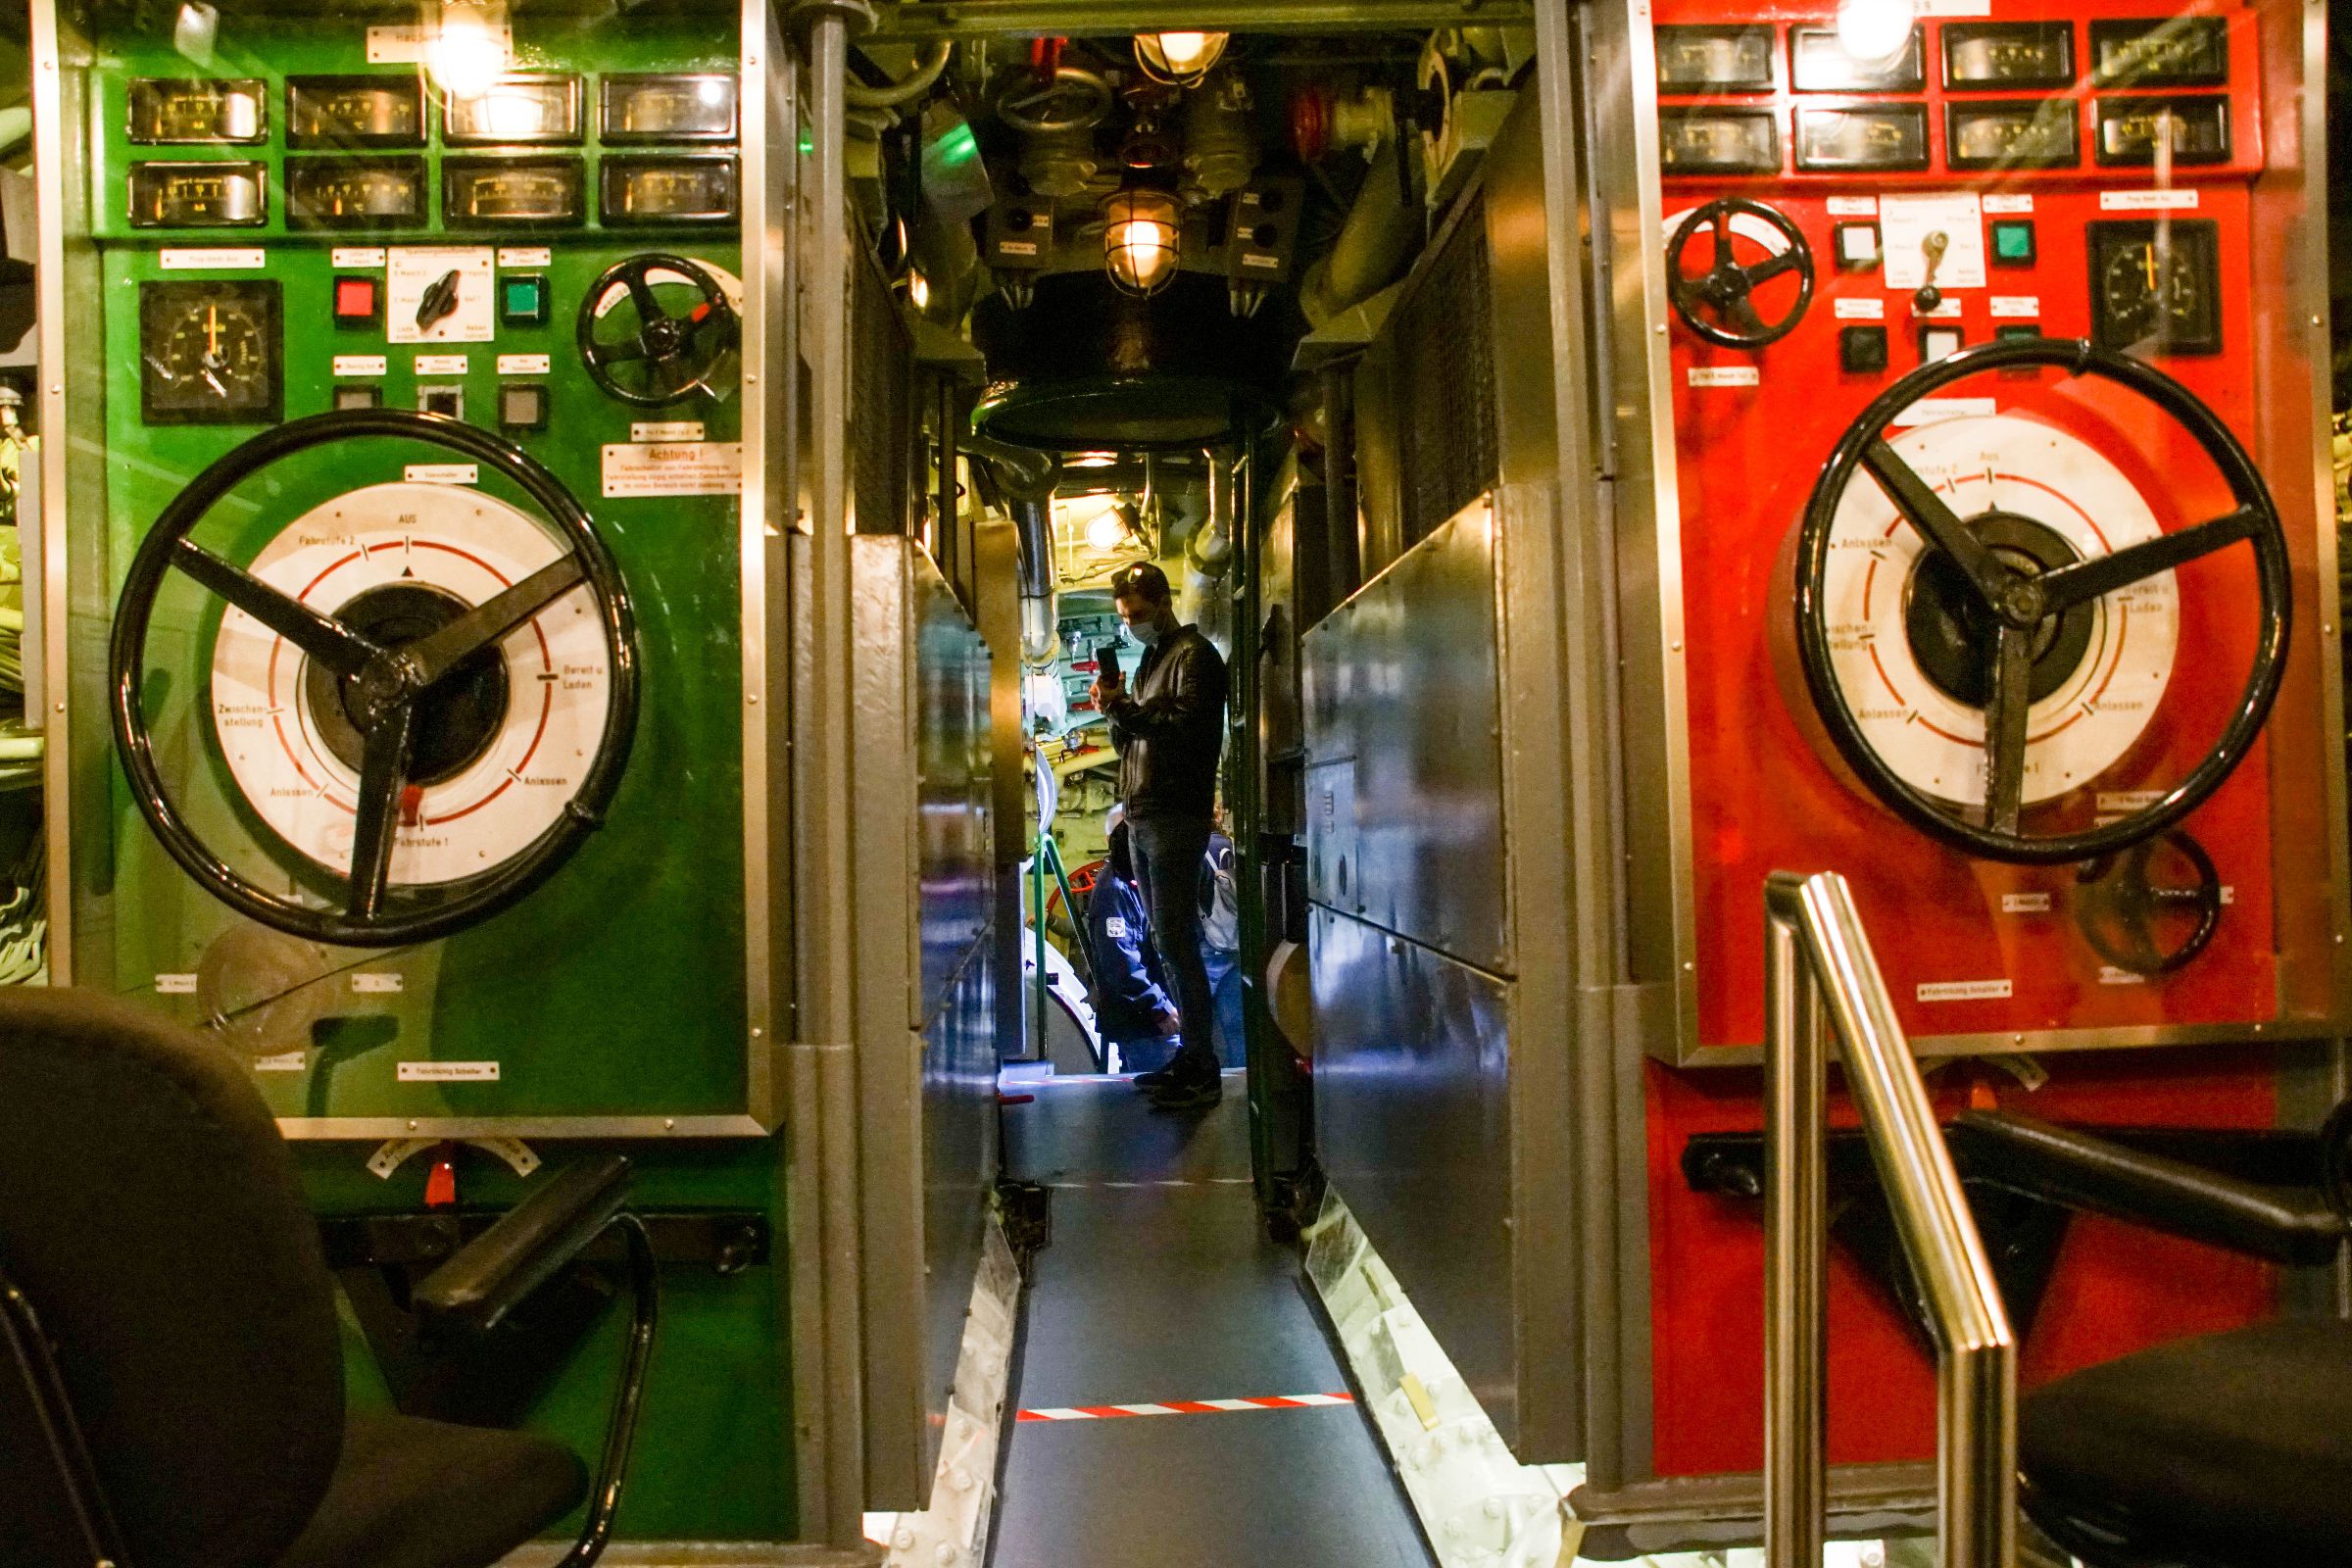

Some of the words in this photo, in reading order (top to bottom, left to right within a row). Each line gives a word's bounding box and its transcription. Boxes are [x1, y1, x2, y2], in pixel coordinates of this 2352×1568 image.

[648, 448, 697, 463] Achtung
[398, 514, 417, 524] AUS
[564, 665, 593, 675] Bereit
[564, 680, 593, 690] Laden
[223, 717, 265, 728] stellung
[524, 776, 568, 786] Anlassen
